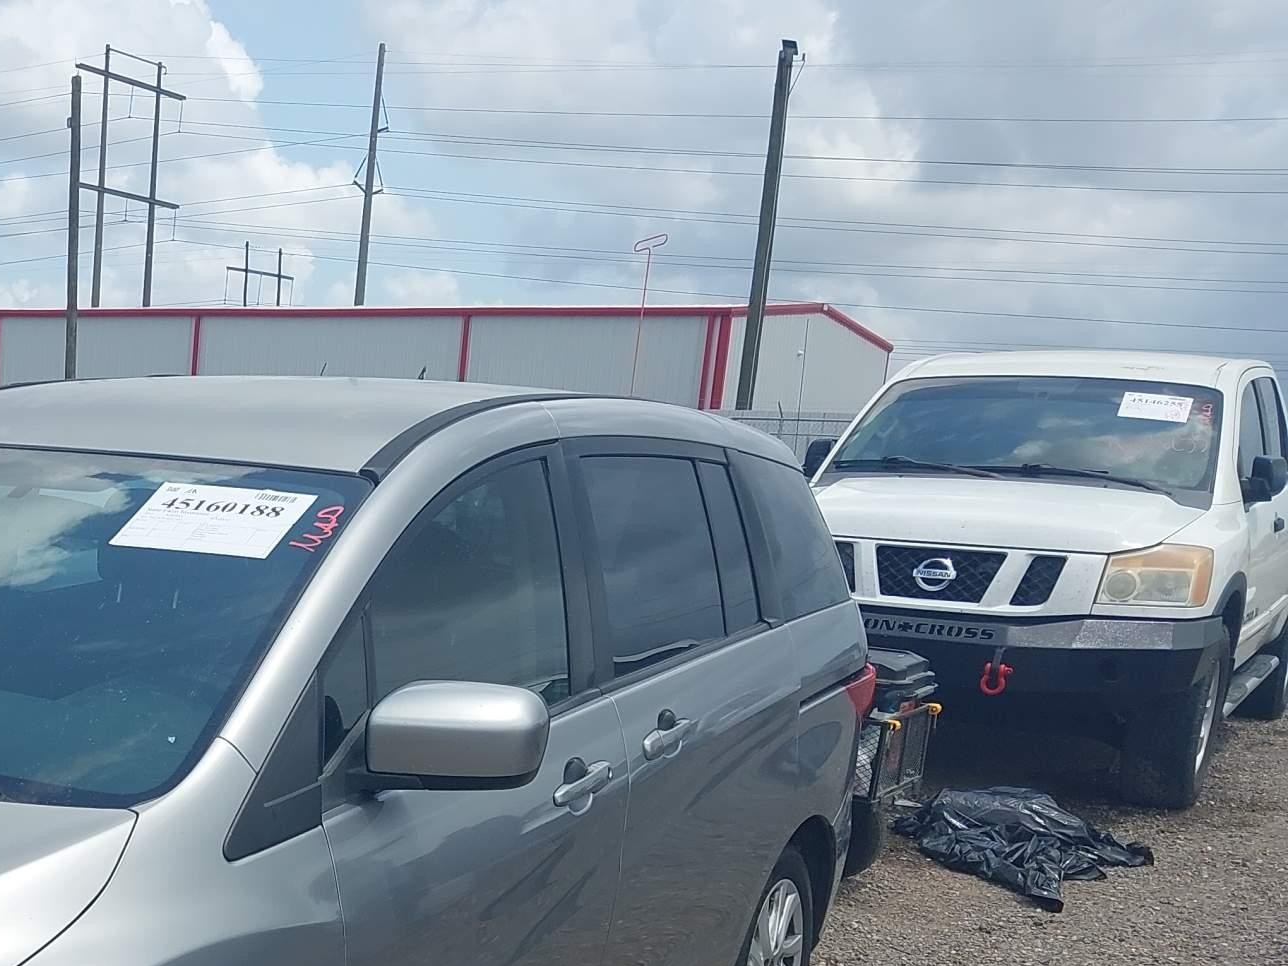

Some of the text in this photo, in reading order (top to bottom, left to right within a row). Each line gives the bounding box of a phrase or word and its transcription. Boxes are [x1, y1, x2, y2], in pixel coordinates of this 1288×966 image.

[160, 497, 285, 518] 45160188
[918, 570, 952, 578] NISSAN
[914, 622, 996, 640] CROSS
